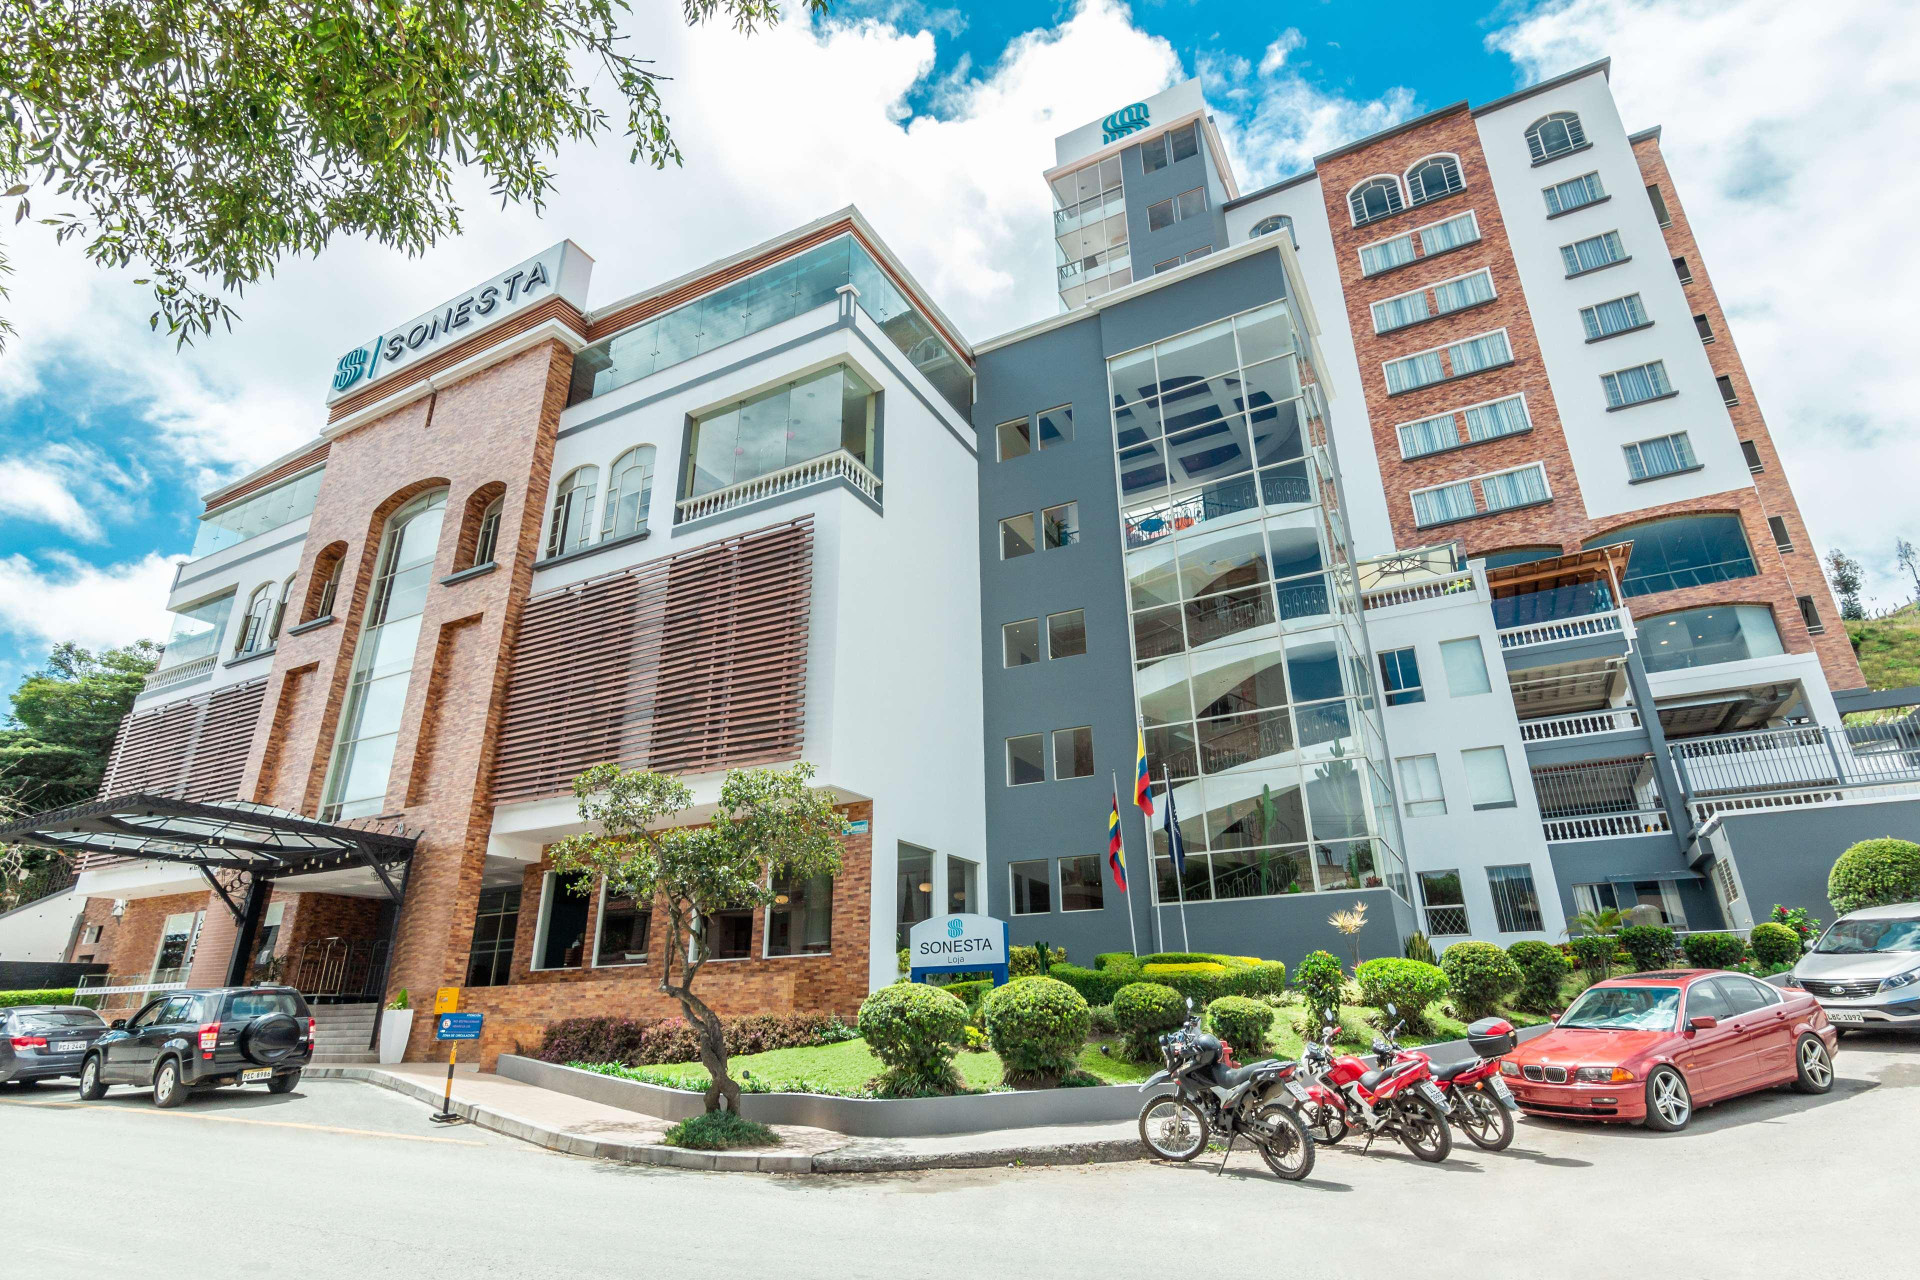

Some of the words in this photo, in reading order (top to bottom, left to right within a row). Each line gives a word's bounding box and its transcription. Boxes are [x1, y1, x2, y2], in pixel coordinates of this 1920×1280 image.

[383, 261, 547, 361] SONESTA
[920, 938, 993, 954] SONESTA
[947, 956, 965, 964] Loja
